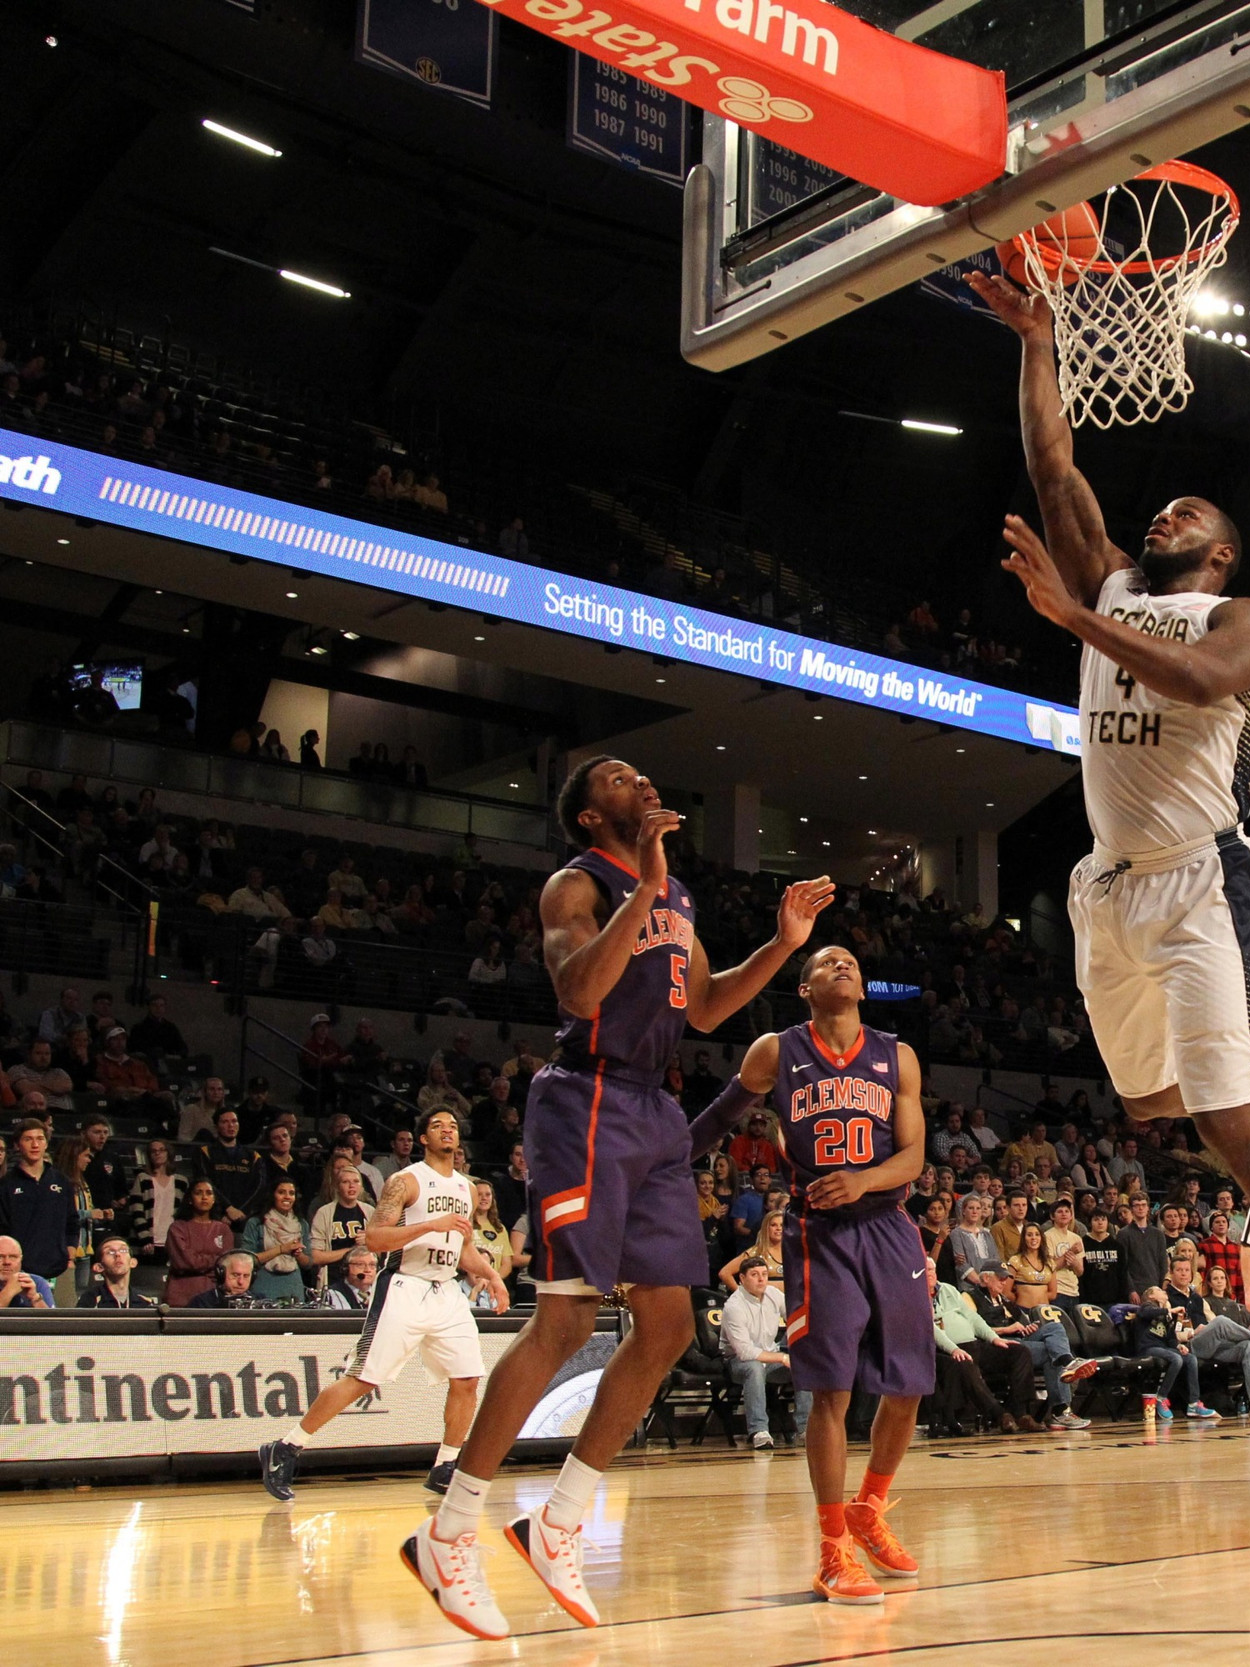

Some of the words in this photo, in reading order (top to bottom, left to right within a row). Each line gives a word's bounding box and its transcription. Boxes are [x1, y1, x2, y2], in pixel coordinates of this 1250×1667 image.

[524, 0, 720, 85] State
[684, 0, 839, 75] arm
[595, 83, 627, 110] 1986
[635, 100, 666, 128] 1990
[594, 109, 625, 136] 1987
[634, 126, 663, 154] 1991
[769, 159, 797, 185] 1996
[804, 175, 828, 194] 20
[936, 265, 961, 282] 90
[966, 253, 992, 272] 004
[544, 583, 623, 637] Setting
[631, 607, 665, 640] the
[673, 616, 763, 665] Standard
[768, 640, 795, 672] for
[799, 648, 878, 698] Moving
[882, 671, 914, 701] the
[1115, 664, 1134, 699] 4
[1089, 711, 1161, 746] TECH
[669, 953, 688, 1009] 5
[791, 1077, 892, 1122] CLEMSON
[814, 1117, 874, 1166] 20
[427, 1196, 469, 1219] GEORGIA
